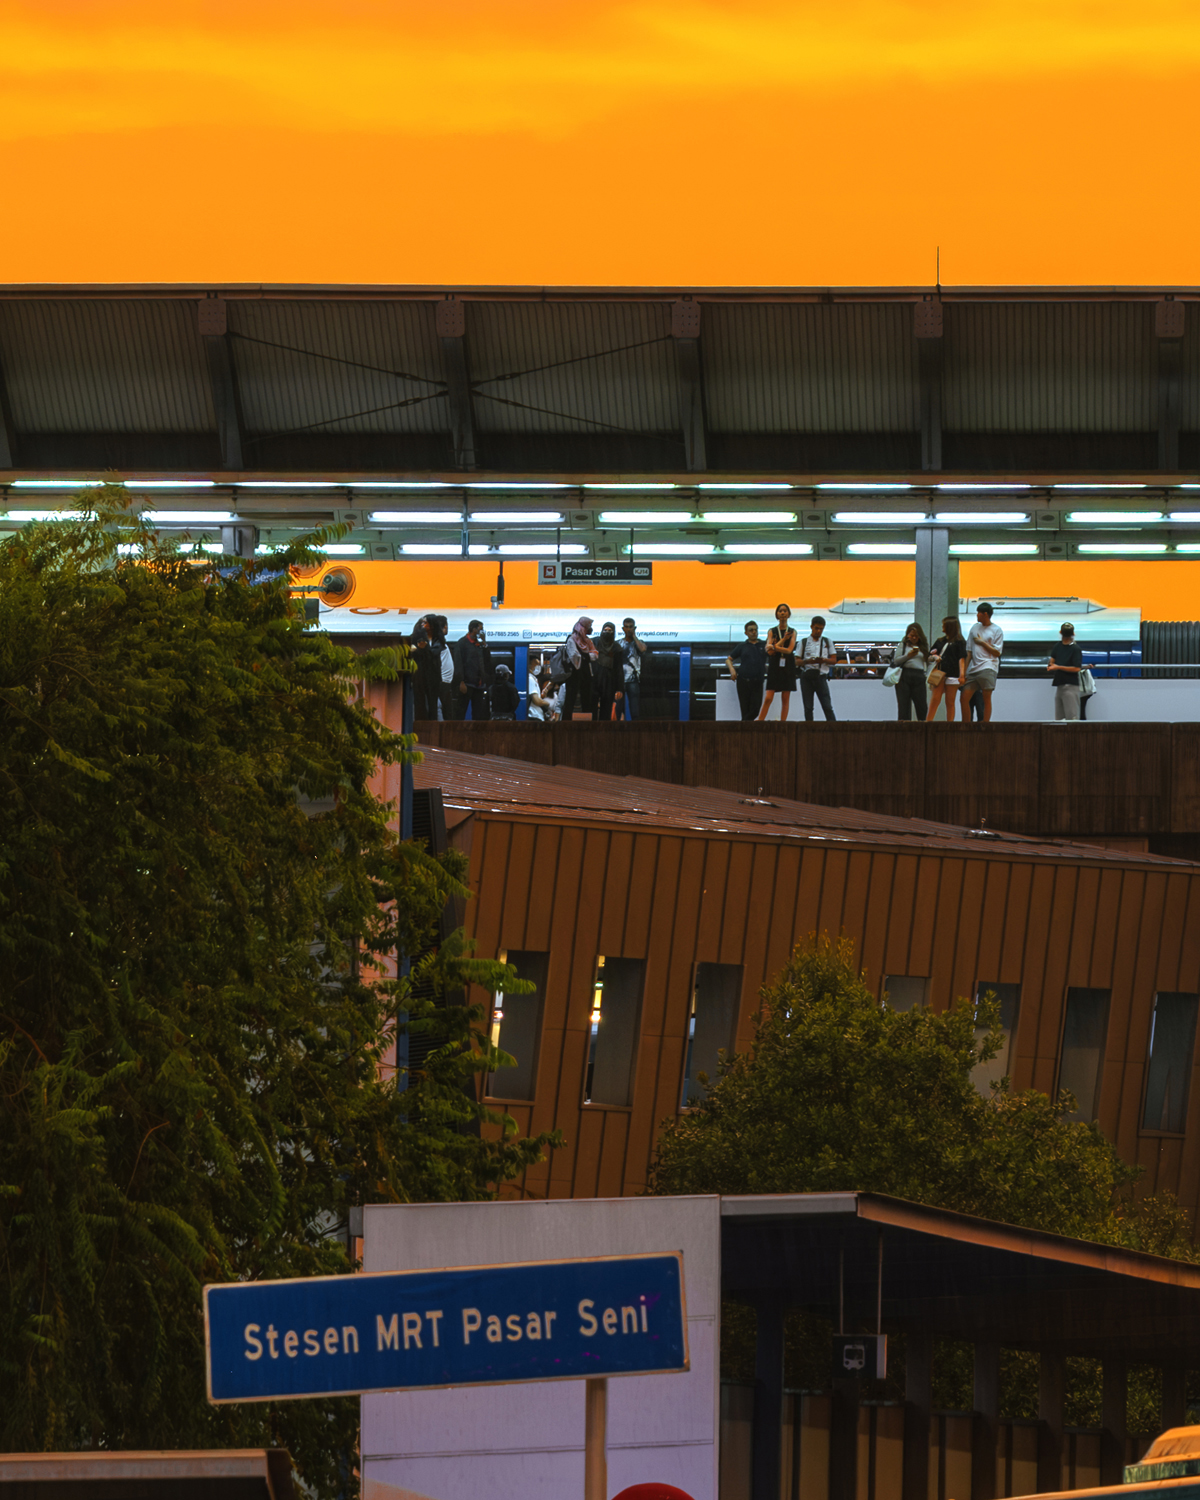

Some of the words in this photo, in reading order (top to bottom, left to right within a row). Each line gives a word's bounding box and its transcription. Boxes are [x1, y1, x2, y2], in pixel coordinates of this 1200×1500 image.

[564, 567, 594, 576] Pasar
[595, 566, 618, 576] Seni
[243, 1323, 360, 1361] Stesen
[375, 1309, 444, 1352] MRT
[461, 1307, 558, 1345] Pasar
[577, 1294, 649, 1338] Seni
